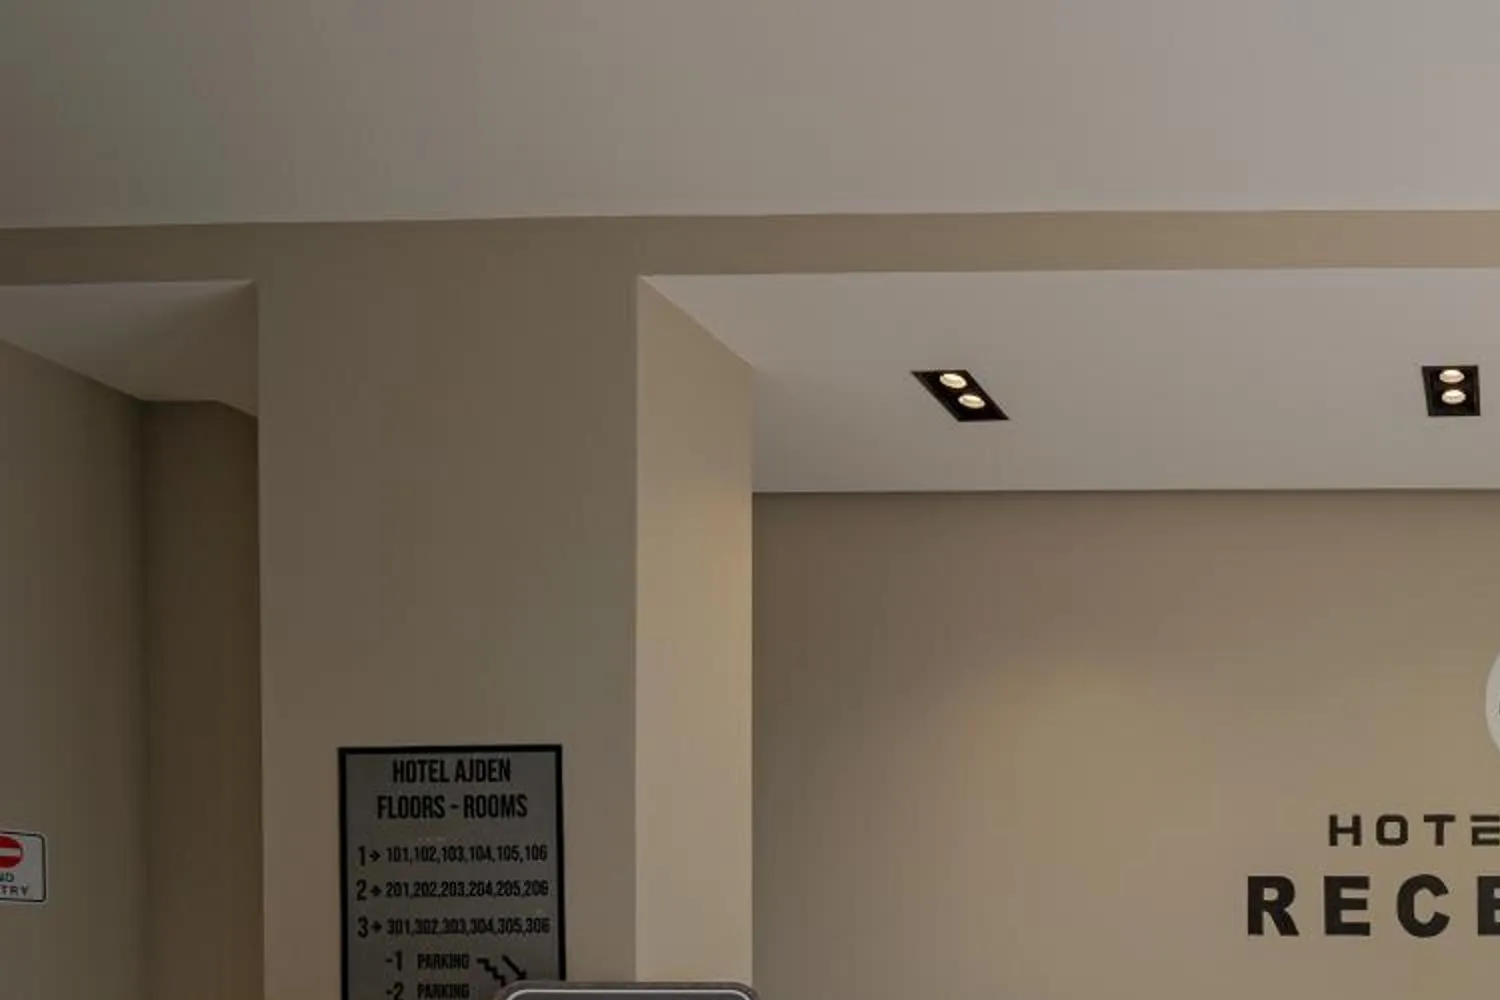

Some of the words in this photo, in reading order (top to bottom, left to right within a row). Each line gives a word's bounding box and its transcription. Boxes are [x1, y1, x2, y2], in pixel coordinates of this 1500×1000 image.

[392, 759, 450, 783] HOTEL
[454, 758, 512, 783] AJDEN
[377, 796, 446, 819] FLOORS
[463, 794, 528, 819] ROOMS
[357, 846, 366, 866] 1
[356, 879, 367, 901] 2
[357, 917, 369, 938] 3
[417, 953, 470, 970] PARKING
[417, 983, 470, 1000] PARKING
